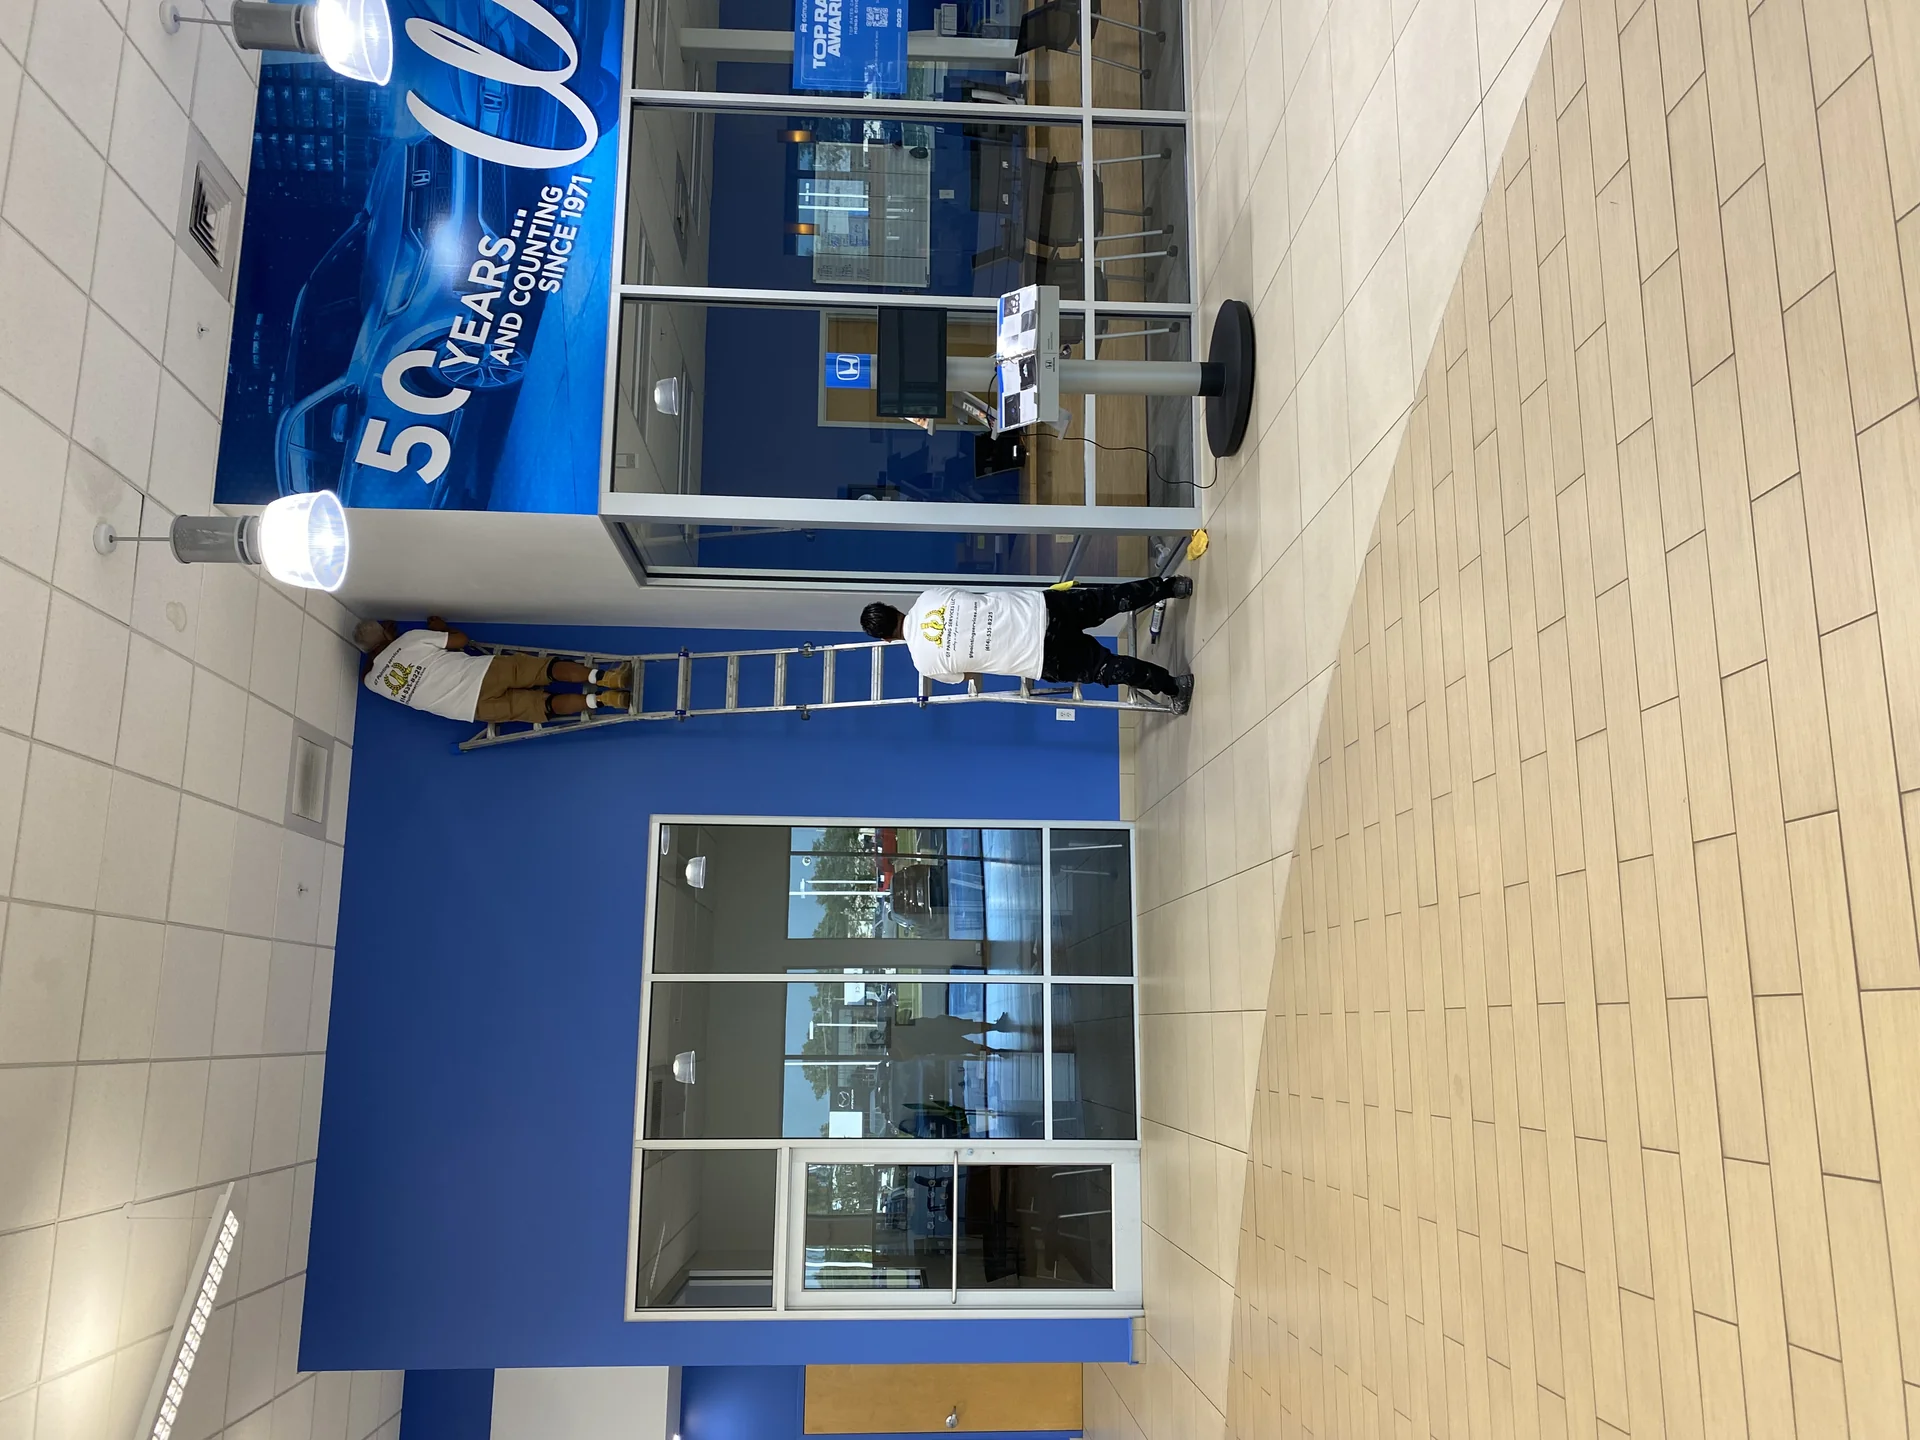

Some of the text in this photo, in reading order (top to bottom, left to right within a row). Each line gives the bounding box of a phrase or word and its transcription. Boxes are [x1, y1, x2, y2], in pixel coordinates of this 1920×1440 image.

[812, 24, 827, 69] TOP
[490, 186, 563, 366] AND COUNTING
[538, 174, 593, 294] SINCE 1971
[355, 350, 472, 484] 50
